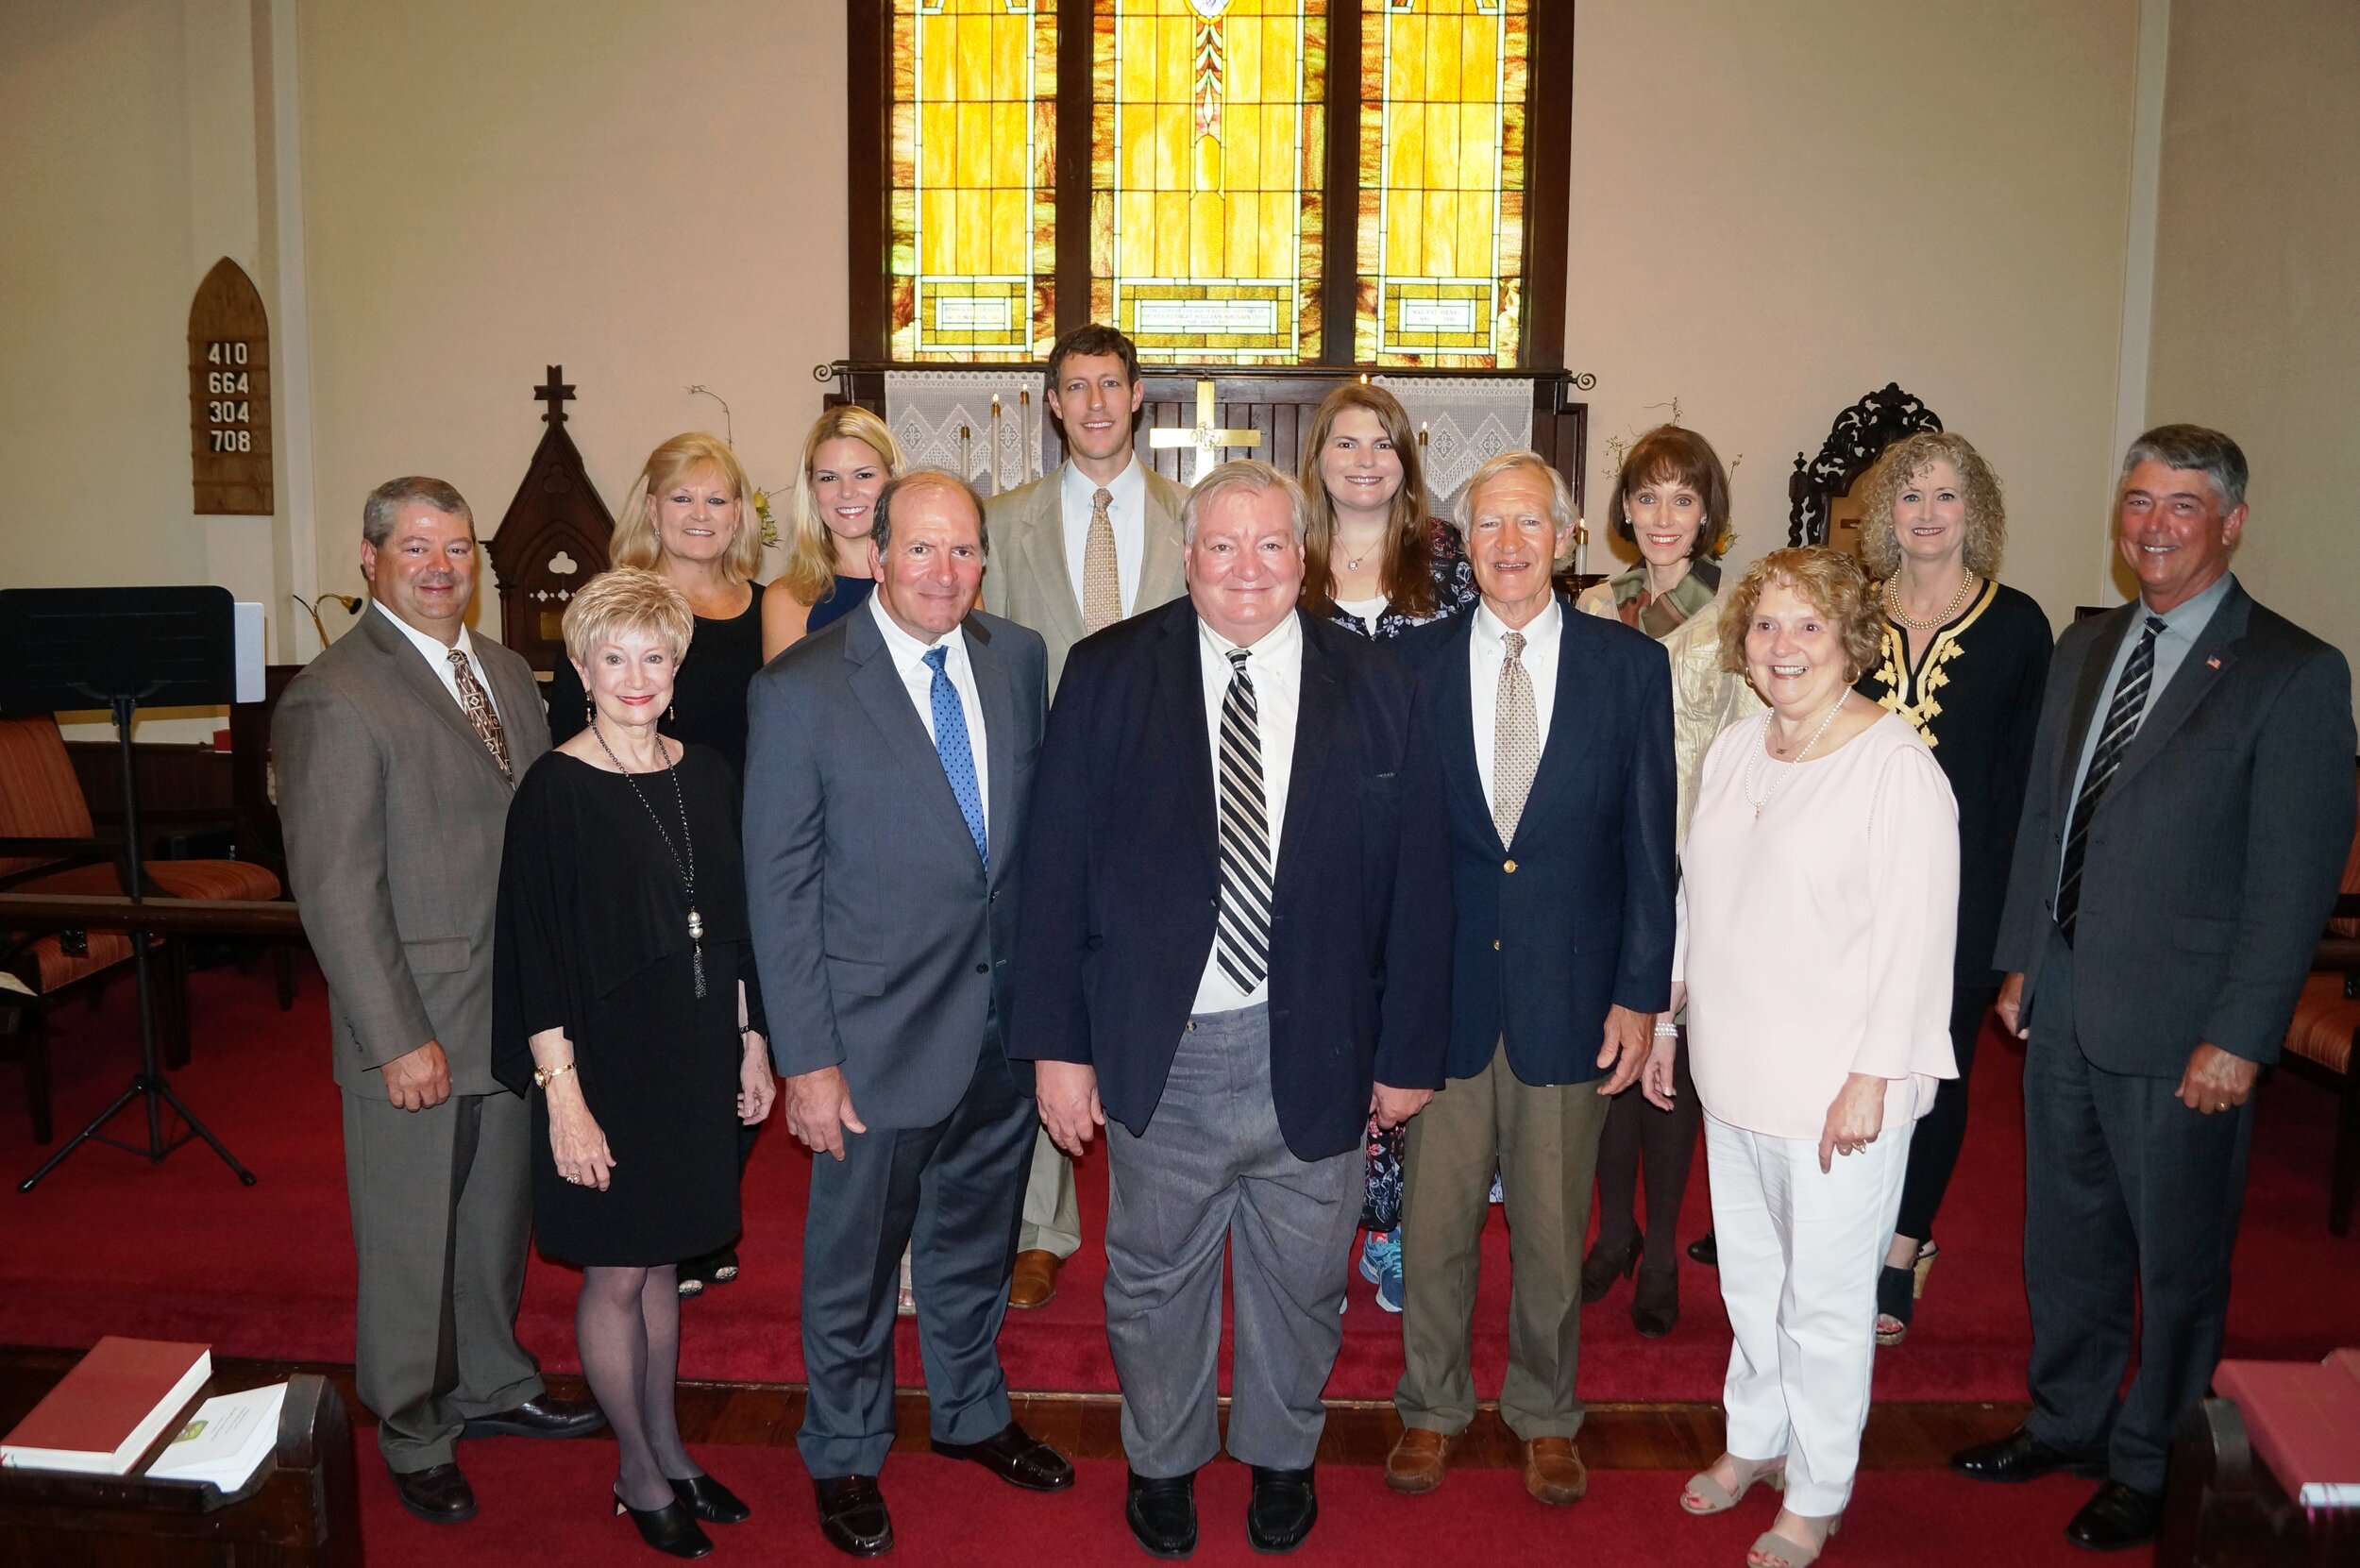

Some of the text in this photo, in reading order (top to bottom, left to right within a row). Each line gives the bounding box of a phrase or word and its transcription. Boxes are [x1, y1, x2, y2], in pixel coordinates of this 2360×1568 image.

[209, 343, 247, 364] 410
[209, 372, 249, 394] 664
[210, 401, 249, 423] 304
[211, 430, 251, 452] 708
